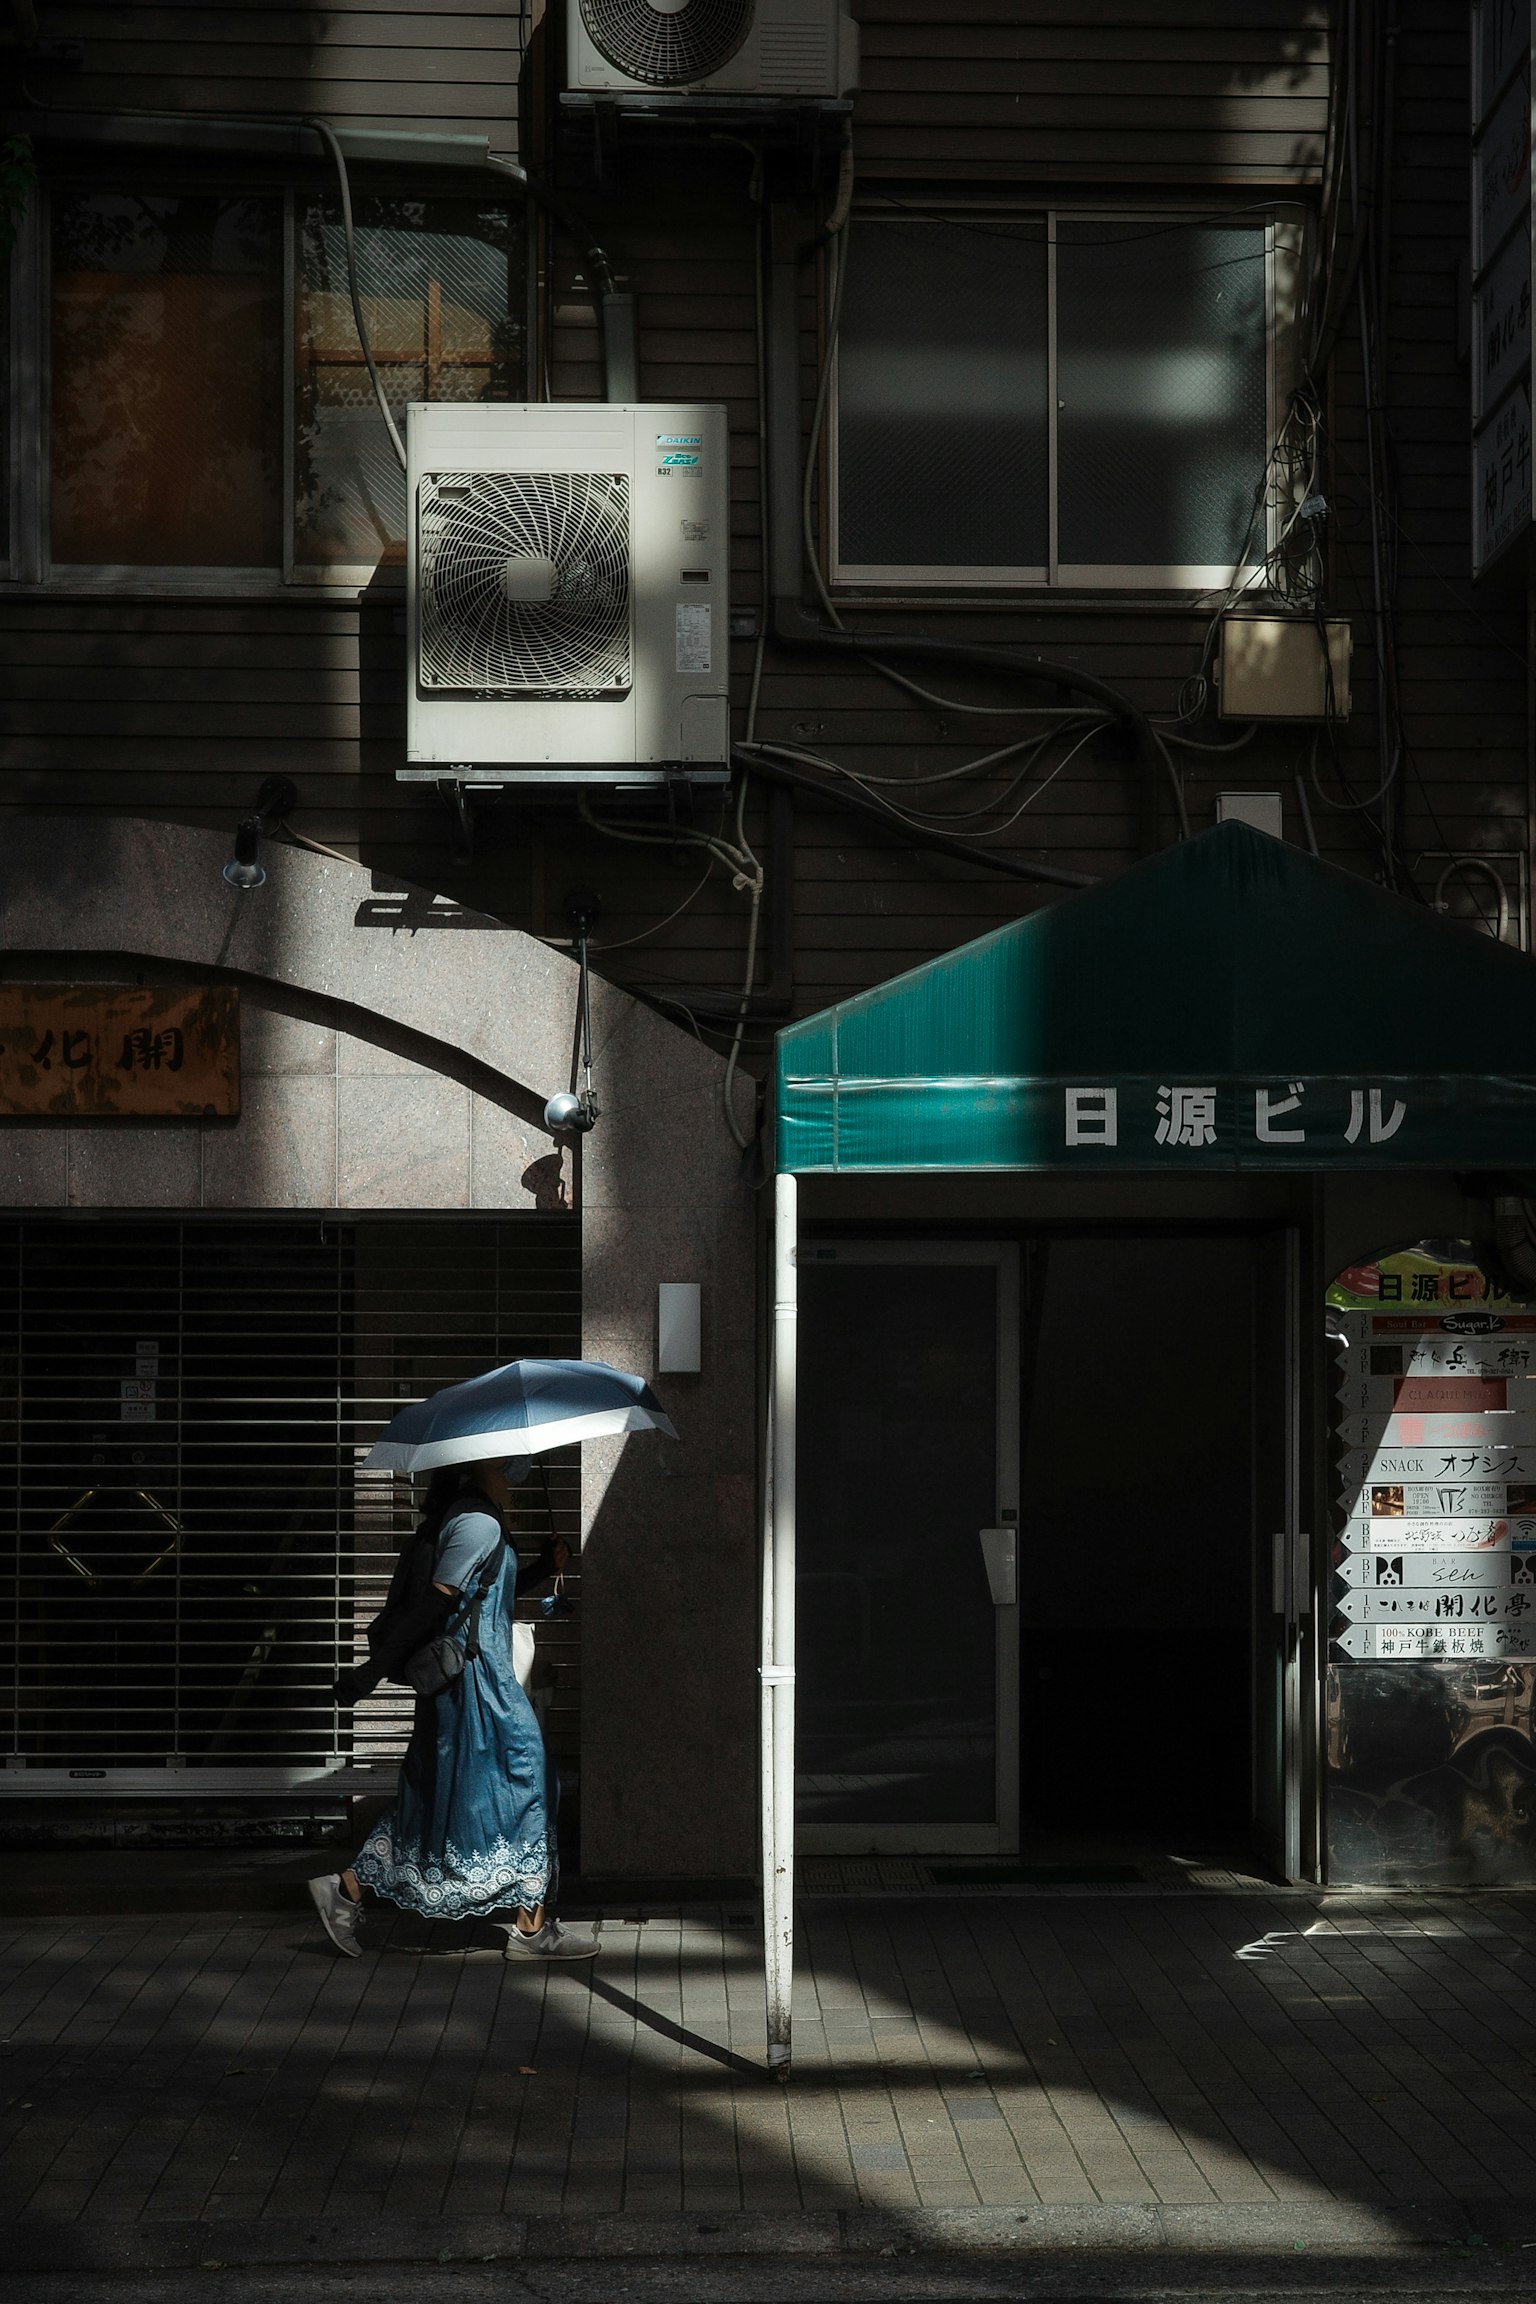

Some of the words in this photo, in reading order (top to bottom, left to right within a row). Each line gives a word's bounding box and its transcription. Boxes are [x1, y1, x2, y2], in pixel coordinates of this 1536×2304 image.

[1484, 424, 1530, 532] 神戸牛
[1065, 1080, 1407, 1147] 日源ビル
[1378, 1274, 1510, 1301] 日源ビル
[1386, 1320, 1408, 1329] Soul
[1410, 1320, 1427, 1329] Bar
[1360, 1384, 1369, 1408] 3F
[1361, 1418, 1370, 1443] 2F
[1380, 1459, 1424, 1472] SNACK
[1434, 1452, 1526, 1478] オナシス
[1361, 1489, 1370, 1514] BF
[1361, 1523, 1370, 1548] BF
[1361, 1558, 1370, 1583] BF
[1434, 1592, 1532, 1618] 開化亭
[1407, 1628, 1443, 1637] KOBE
[1449, 1628, 1485, 1637] BEEF
[1381, 1638, 1485, 1654] 神戸牛鉄板焼
